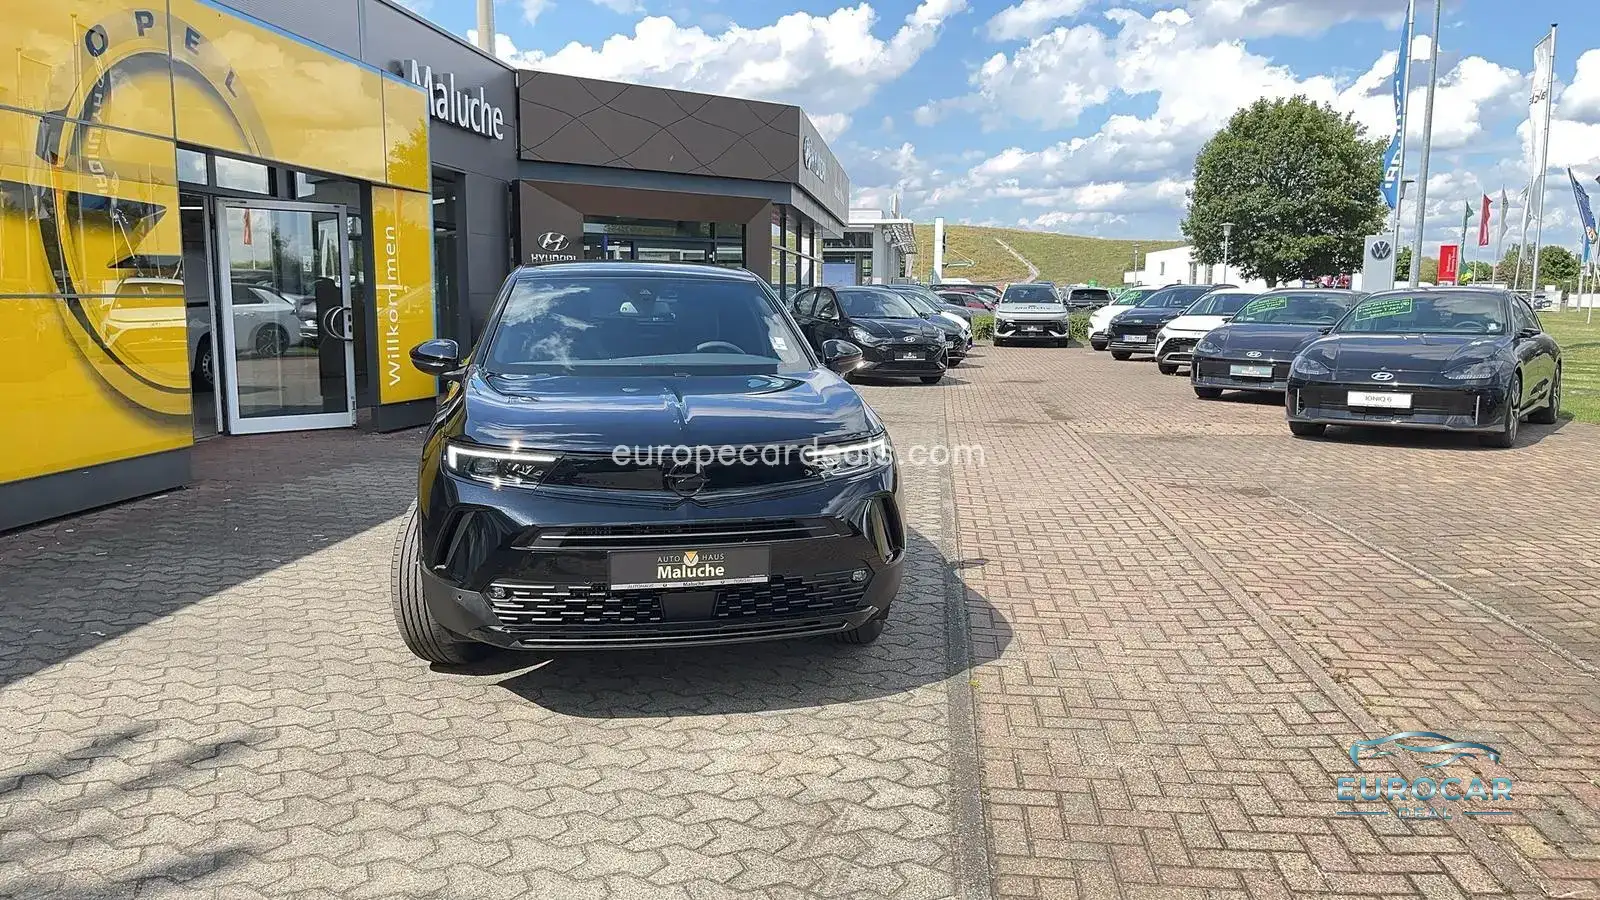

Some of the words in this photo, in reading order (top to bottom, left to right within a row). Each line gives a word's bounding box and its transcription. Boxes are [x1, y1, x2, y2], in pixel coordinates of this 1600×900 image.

[85, 11, 238, 98] OPEL
[411, 59, 504, 140] Maluche
[384, 226, 402, 387] Willkommen
[657, 555, 681, 564] AUTO
[702, 552, 725, 561] HAUS
[657, 563, 725, 579] Maluche
